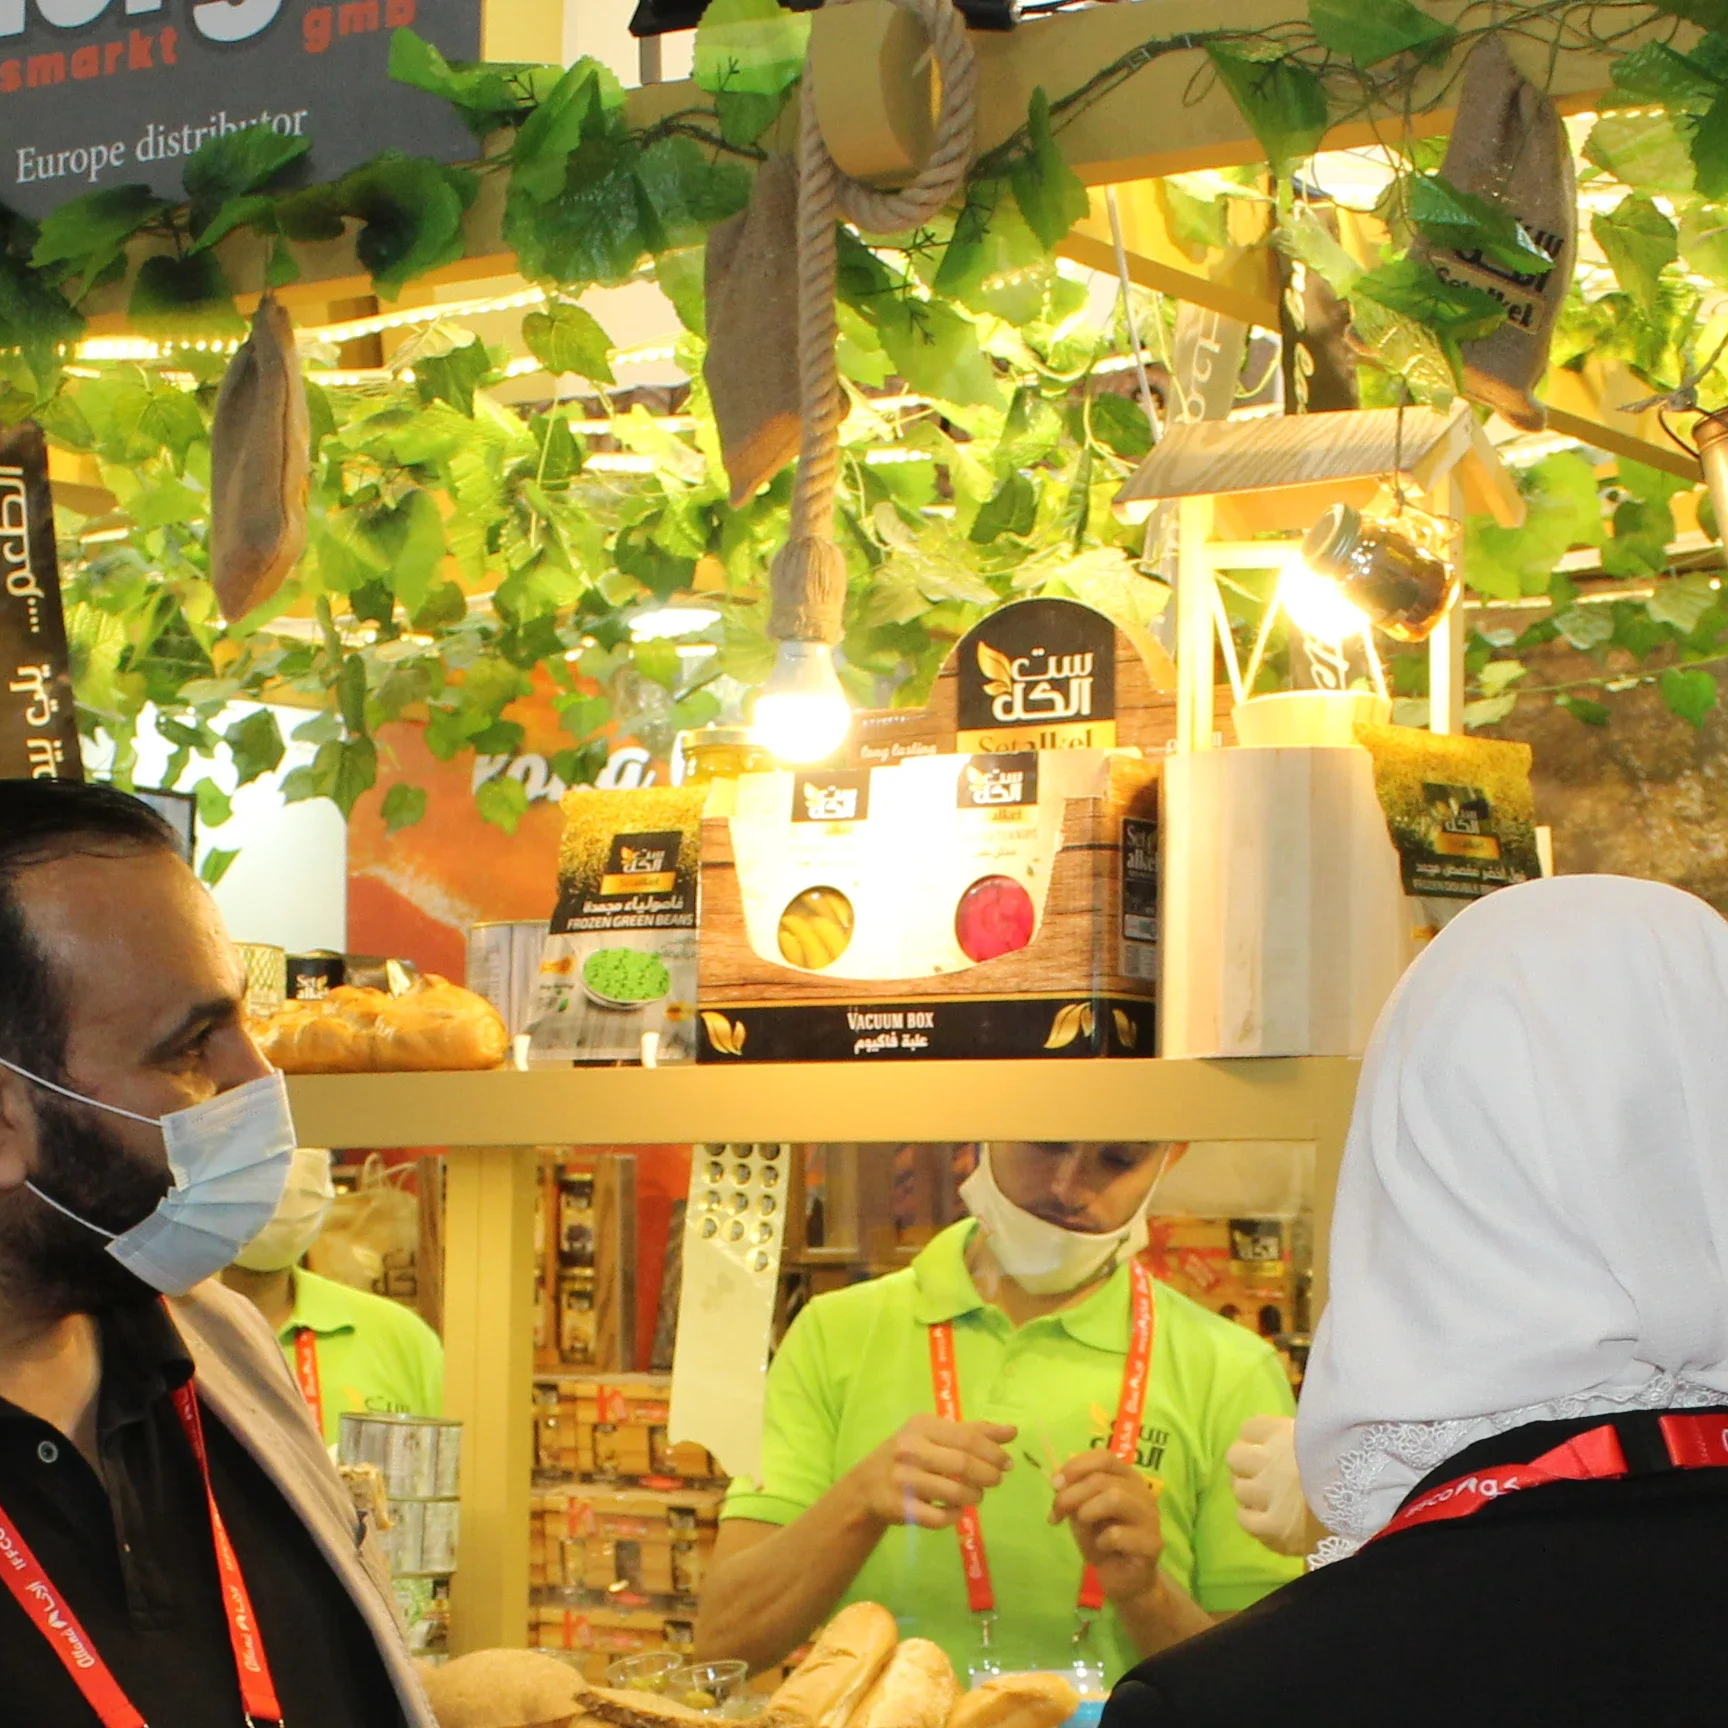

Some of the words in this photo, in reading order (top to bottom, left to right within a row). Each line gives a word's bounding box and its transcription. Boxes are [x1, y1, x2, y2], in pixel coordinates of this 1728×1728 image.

[16, 143, 124, 184] Europe
[1010, 645, 1095, 679] ست
[993, 675, 1093, 721] الكل
[566, 916, 612, 931] FROZEN
[613, 915, 654, 929] GREEN
[654, 912, 693, 928] BEANS
[846, 1010, 905, 1031] VACUUM
[906, 1010, 935, 1031] BOX
